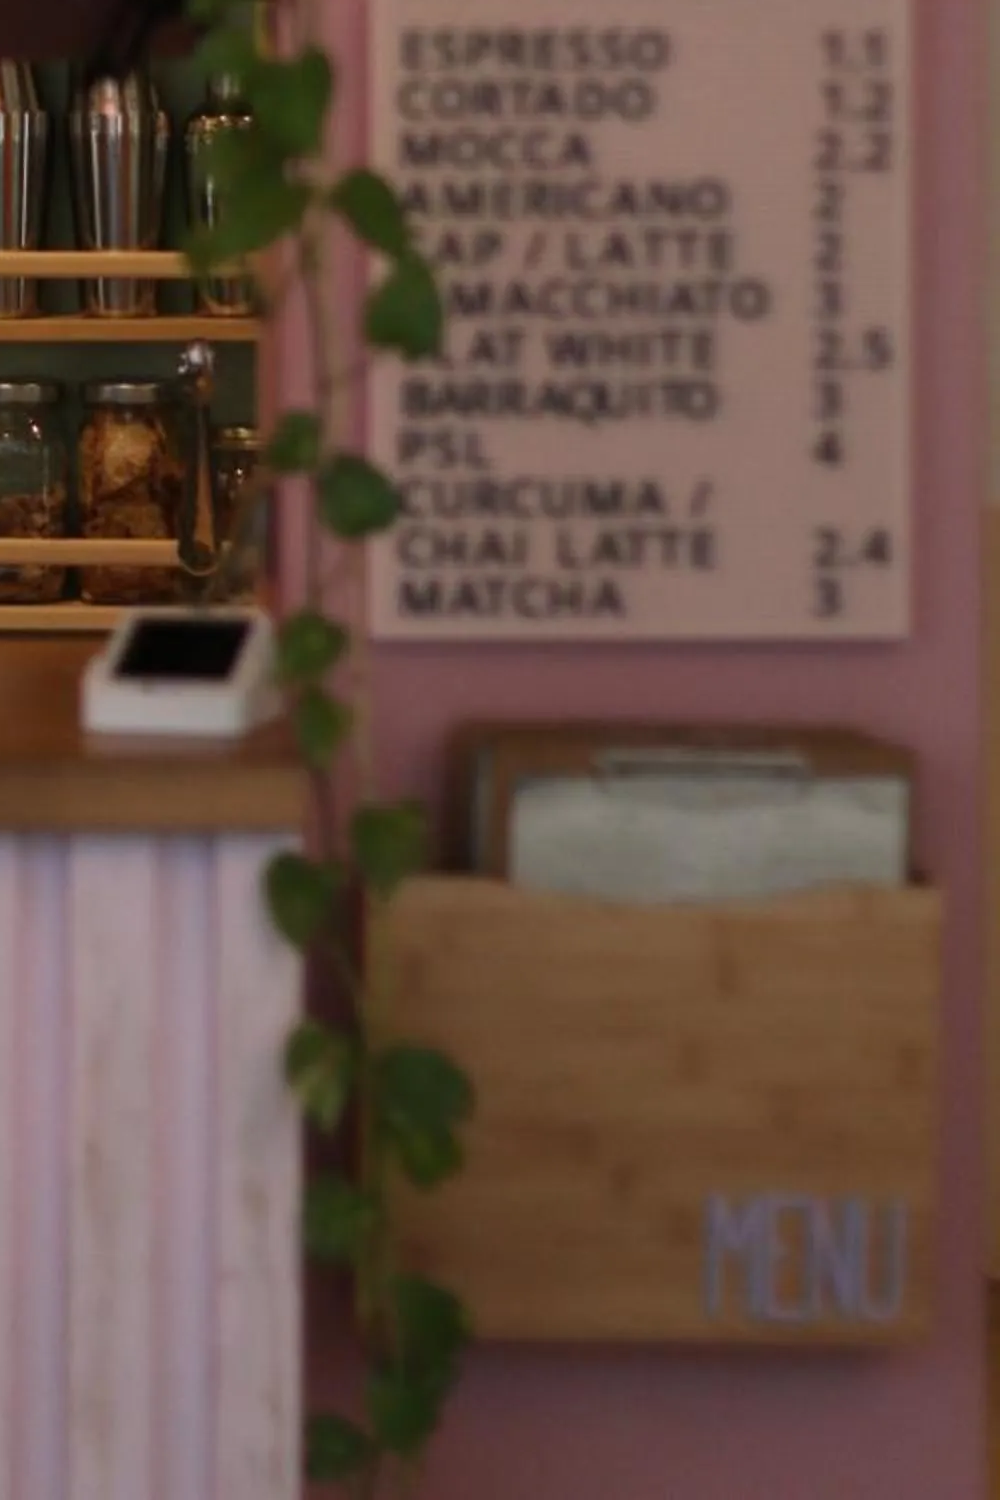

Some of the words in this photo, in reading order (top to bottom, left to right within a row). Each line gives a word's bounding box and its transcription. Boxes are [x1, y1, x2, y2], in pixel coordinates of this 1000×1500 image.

[401, 32, 672, 69] ESPRESSO
[396, 81, 653, 117] CORTADO
[823, 82, 892, 120] 1.2
[401, 133, 590, 165] MOCCA
[814, 130, 892, 169] 2.2
[398, 183, 725, 217] AMERICANO
[565, 232, 732, 270] LATTE
[448, 281, 772, 318] MACCHIATO
[440, 330, 524, 363] AT
[547, 332, 712, 367] WHITE
[814, 329, 893, 369] 2.5
[402, 381, 718, 422] BARRAQUITO
[397, 431, 487, 468] PSL
[814, 432, 843, 465] 4
[396, 482, 664, 517] CURCUMA
[398, 531, 525, 563] CHAI
[557, 529, 714, 568] LATTE
[815, 530, 892, 569] 2.4
[399, 582, 622, 615] MATCHA
[706, 1192, 906, 1322] MENU
